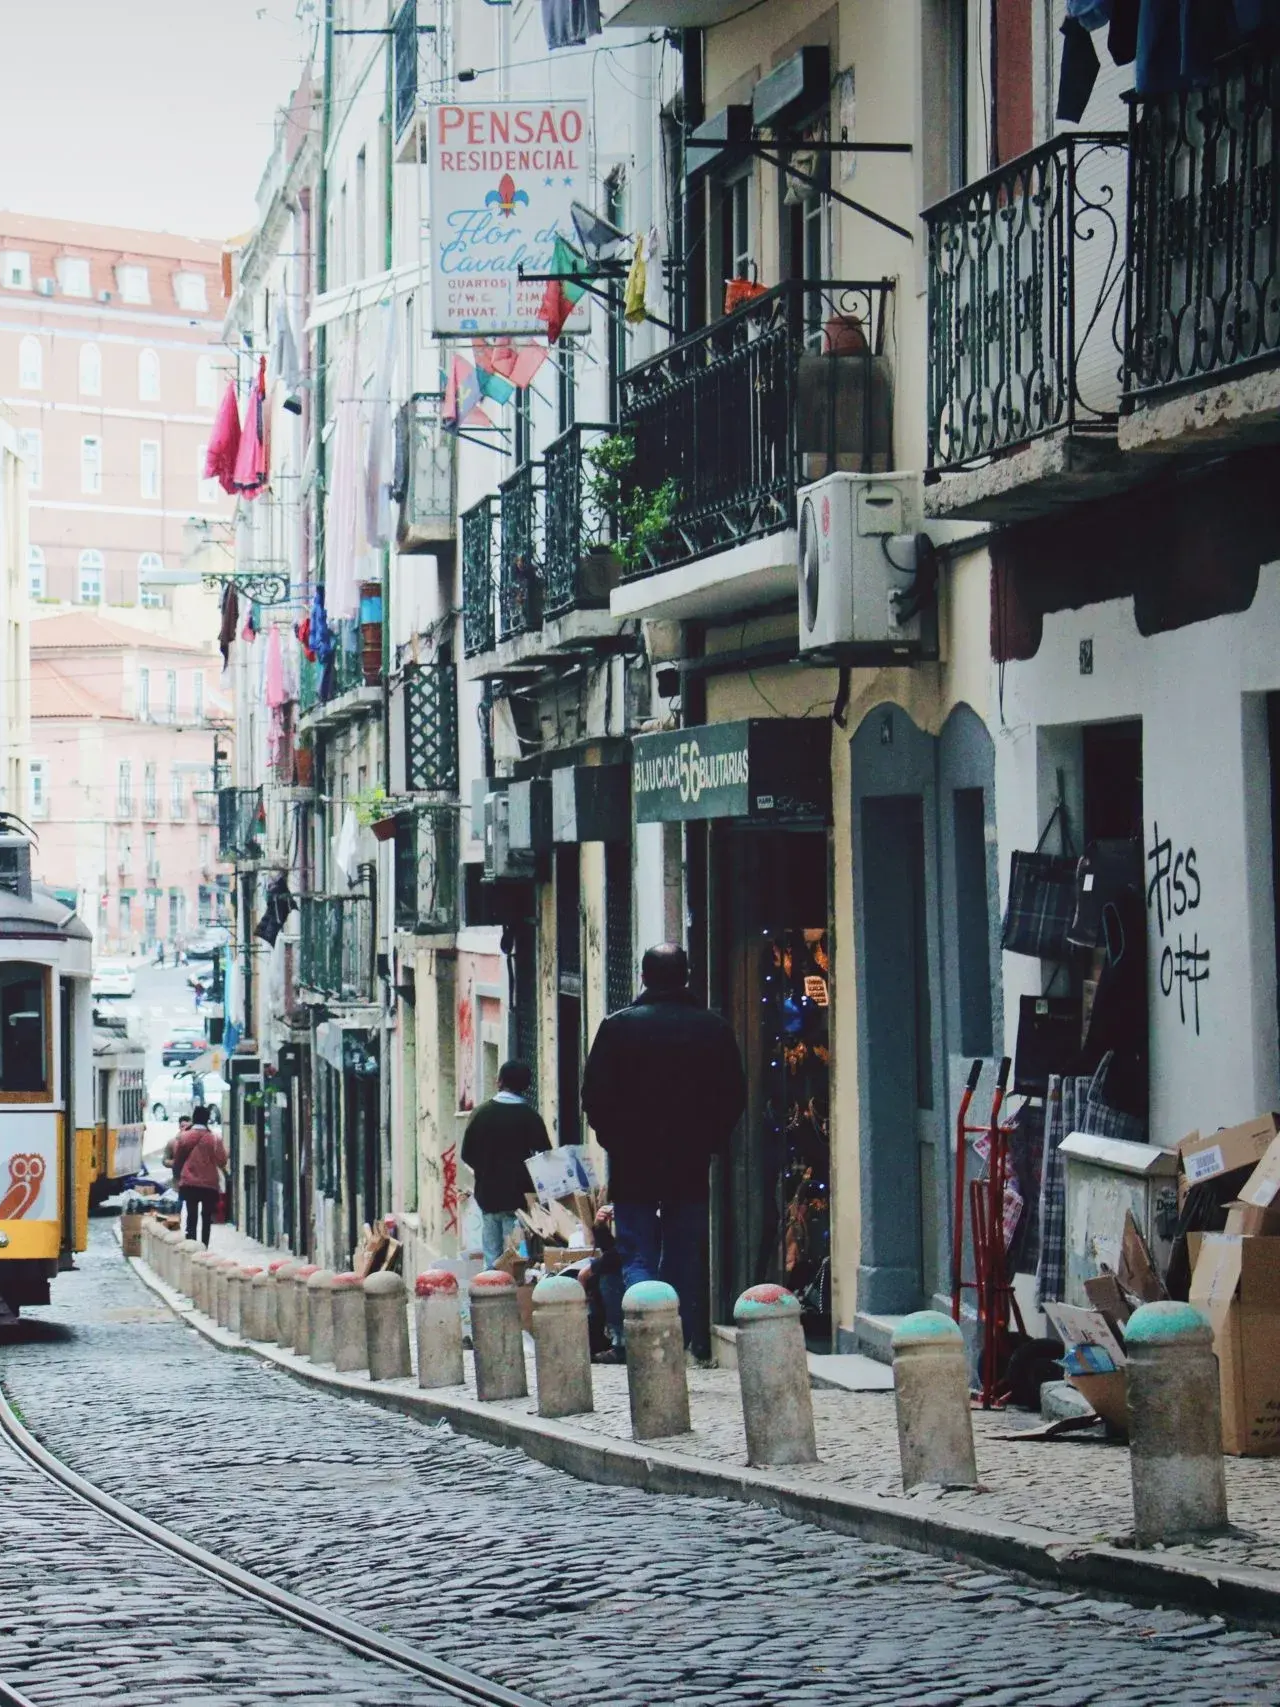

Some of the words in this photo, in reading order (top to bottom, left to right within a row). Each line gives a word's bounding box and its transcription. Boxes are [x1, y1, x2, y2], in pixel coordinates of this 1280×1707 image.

[440, 150, 580, 172] RESIDENCIAL
[440, 240, 554, 274] Cavaleir
[447, 278, 508, 289] QUARTOS
[679, 740, 701, 803] 56
[699, 749, 749, 789] BIJUTARIAS
